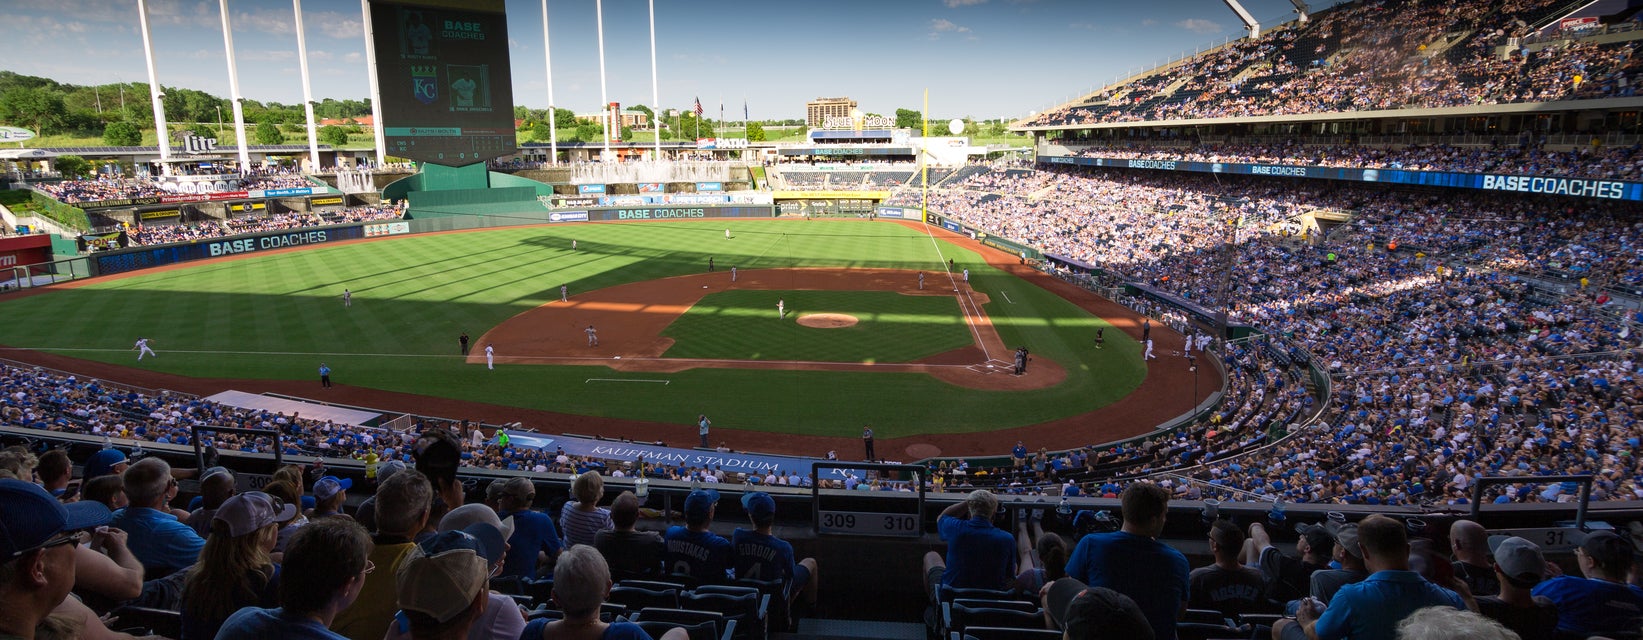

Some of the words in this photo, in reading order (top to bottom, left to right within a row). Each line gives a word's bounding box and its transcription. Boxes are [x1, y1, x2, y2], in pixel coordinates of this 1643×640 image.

[444, 20, 481, 32] BASE
[442, 30, 485, 41] COACHES
[413, 78, 436, 99] KC
[822, 114, 852, 130] BLUE
[865, 115, 896, 127] MOON
[184, 136, 217, 154] Lite
[716, 138, 747, 149] PATIO
[1128, 160, 1145, 168] BASE
[1145, 161, 1175, 170] COACHES
[1252, 166, 1271, 174] BASE
[1271, 167, 1306, 176] COACHES
[1483, 175, 1530, 192] BASE
[1531, 177, 1624, 199] COACHES
[619, 210, 650, 219] BASE
[655, 208, 704, 218] COACHES
[209, 239, 255, 257] BASE
[260, 231, 327, 250] COACHES
[592, 446, 690, 462] KAUFFMAN
[692, 455, 779, 472] STADIUM
[823, 513, 856, 528] 309
[883, 515, 915, 530] 310
[667, 539, 710, 561] MOUSTAKAS
[739, 543, 777, 562] GORDON
